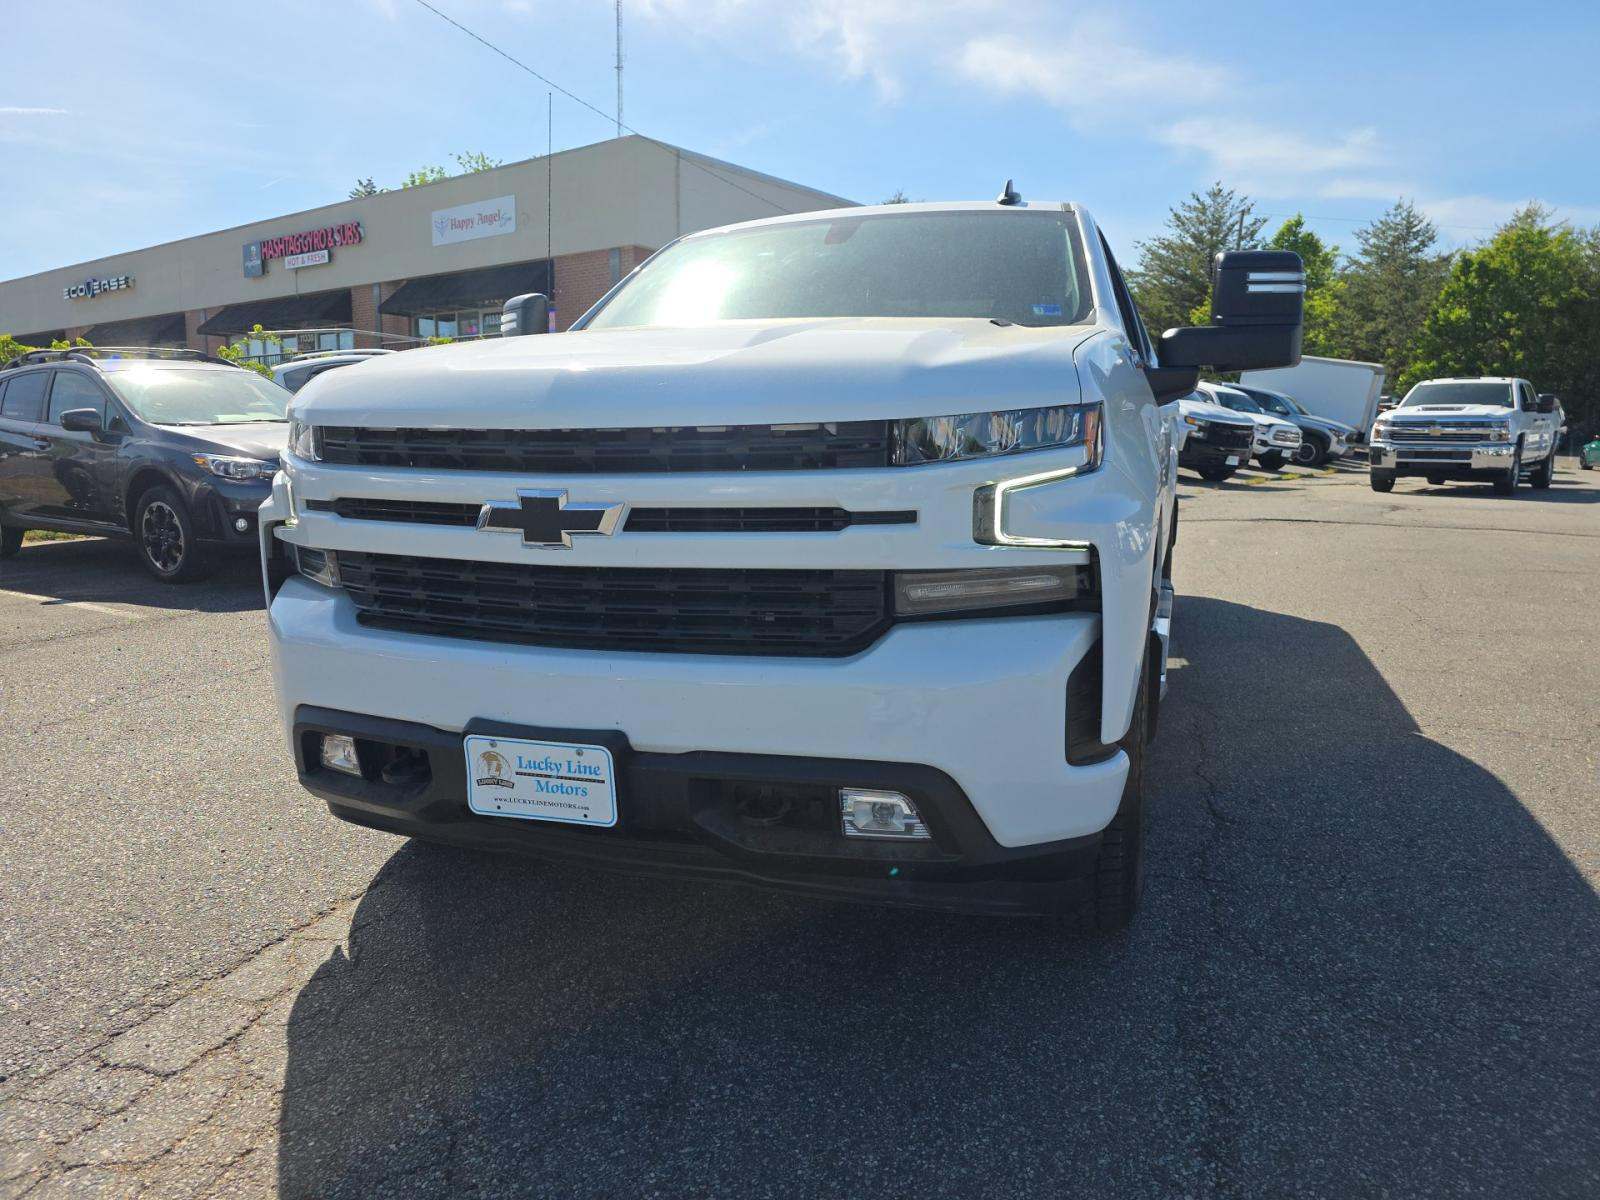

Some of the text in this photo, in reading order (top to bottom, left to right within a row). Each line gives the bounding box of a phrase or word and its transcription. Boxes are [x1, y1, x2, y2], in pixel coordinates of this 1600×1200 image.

[450, 216, 475, 230] Happy
[477, 209, 501, 225] Angel
[262, 234, 301, 259] HASHTAG
[301, 228, 327, 252] GYRO
[335, 220, 361, 246] SUBS
[287, 256, 300, 266] HOT
[307, 252, 326, 263] FRESH
[517, 756, 601, 776] Lucky Line
[535, 779, 589, 797] Motors
